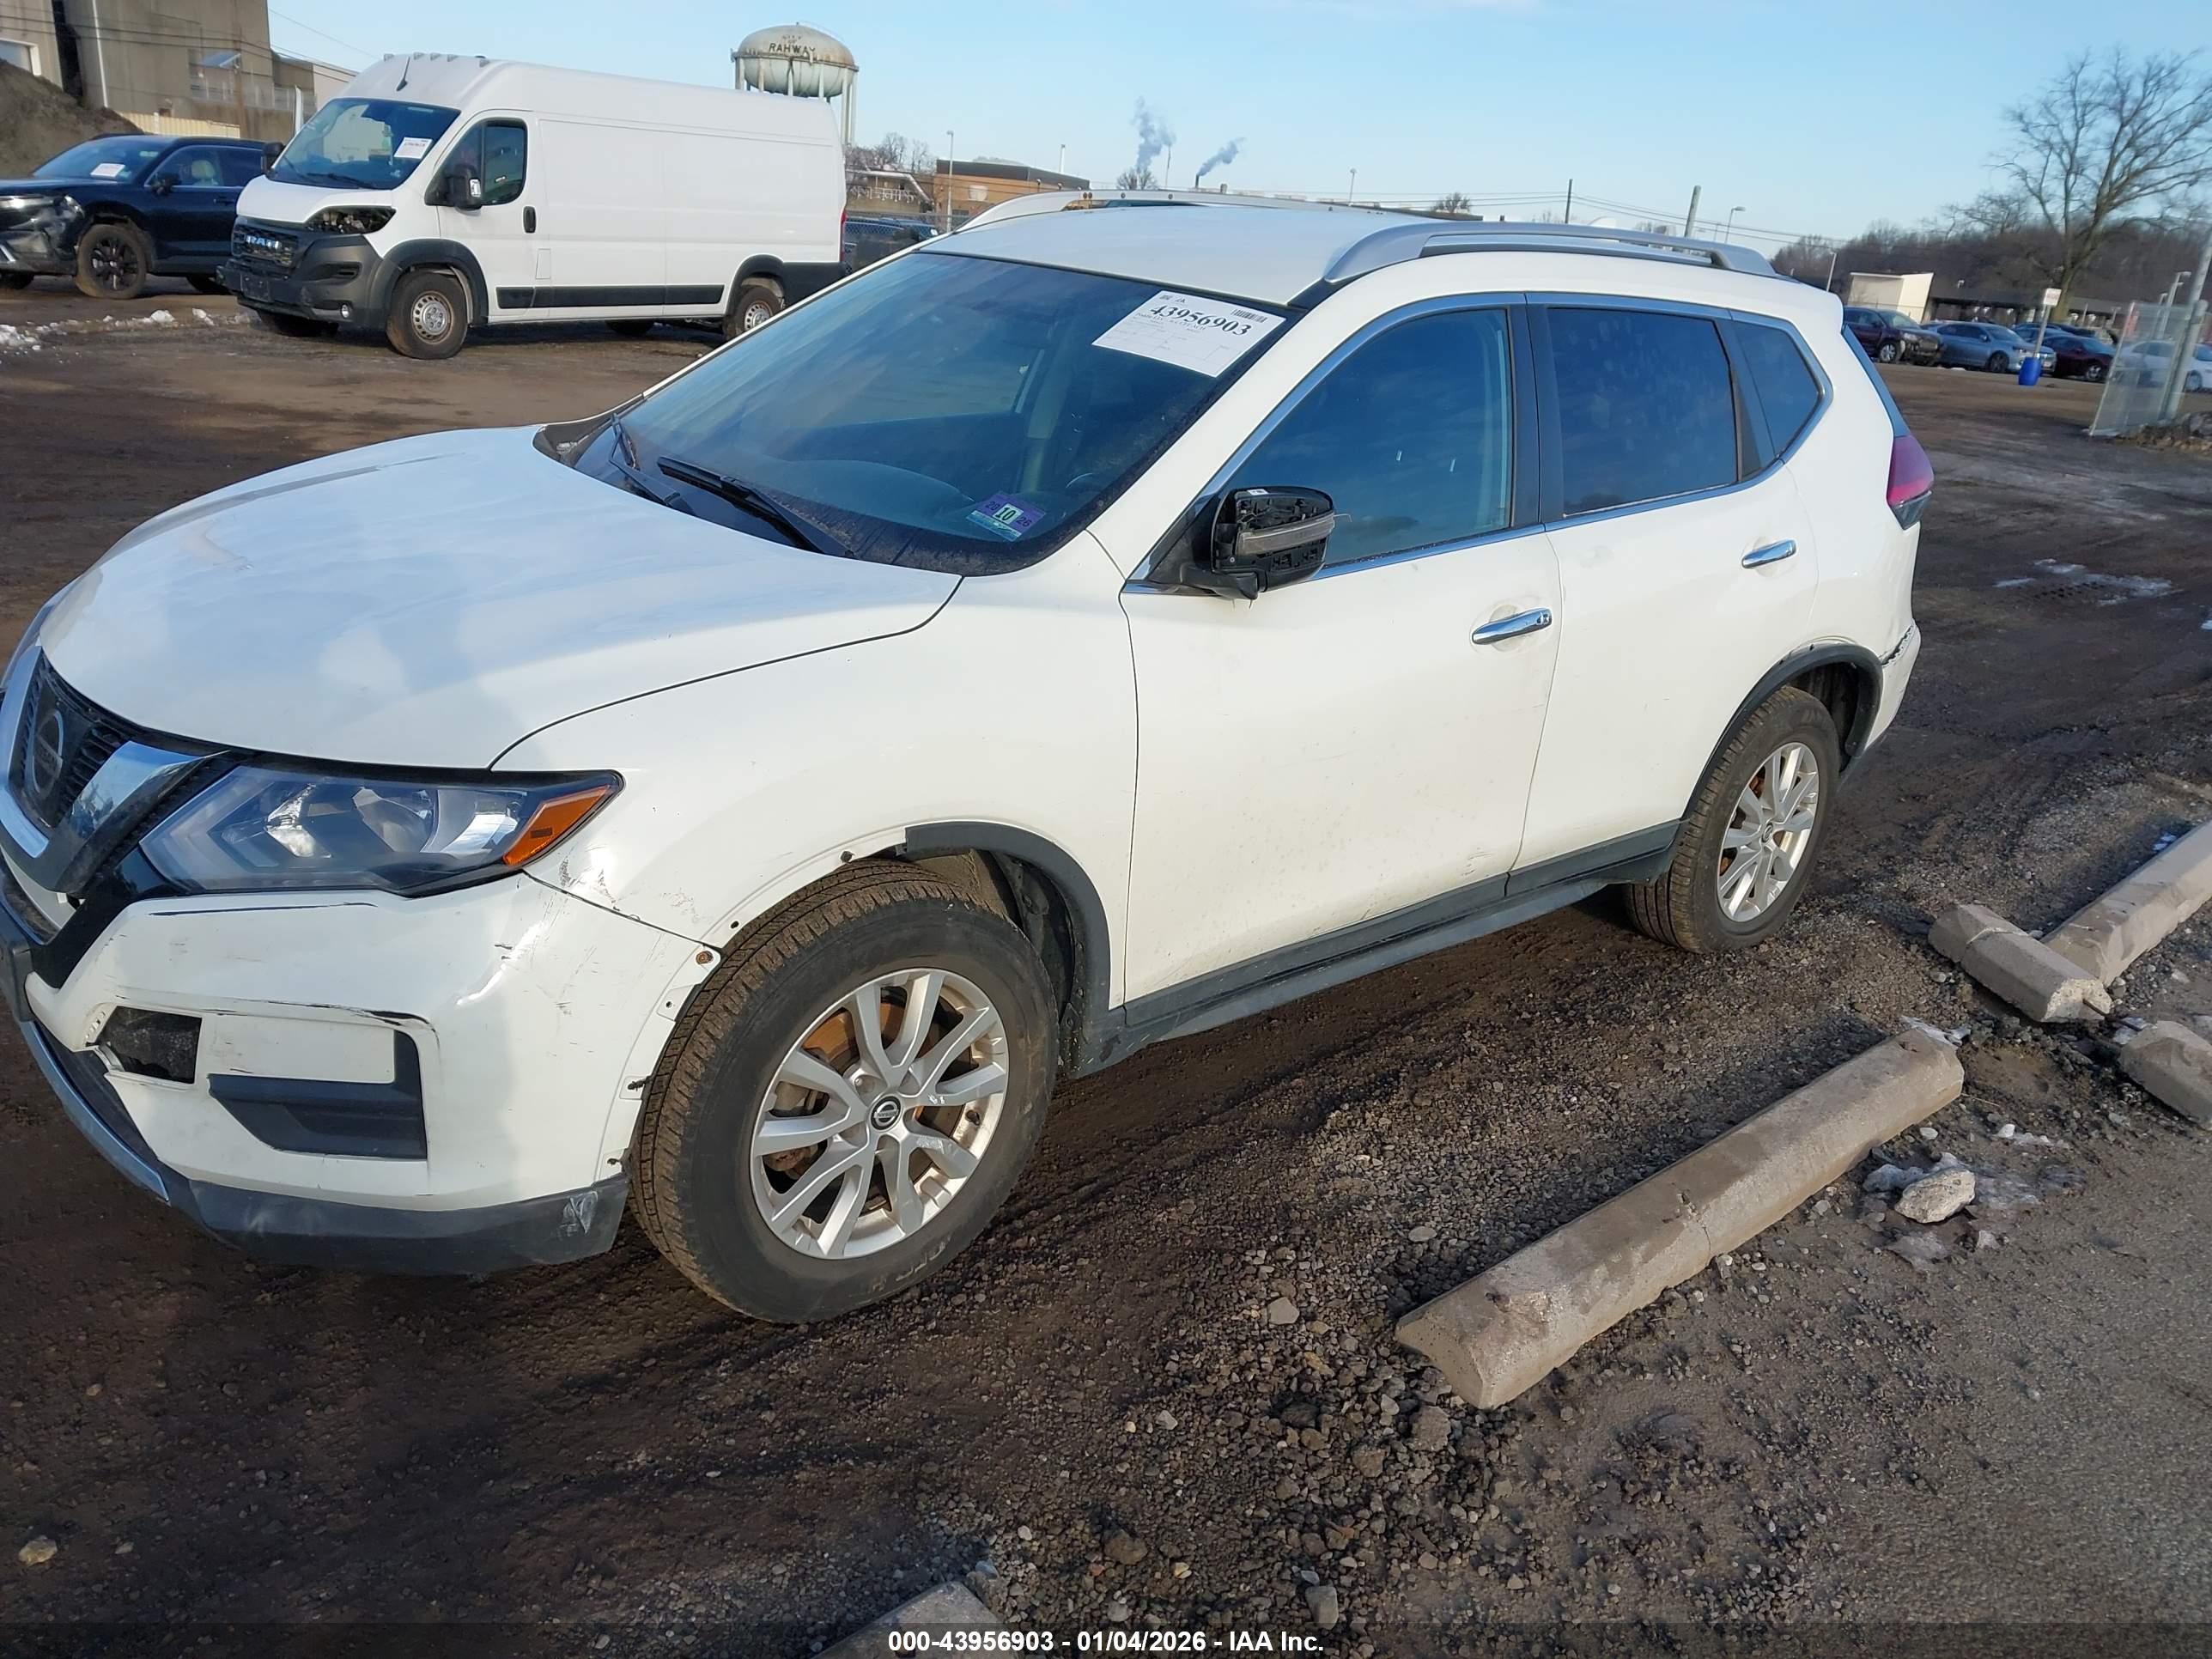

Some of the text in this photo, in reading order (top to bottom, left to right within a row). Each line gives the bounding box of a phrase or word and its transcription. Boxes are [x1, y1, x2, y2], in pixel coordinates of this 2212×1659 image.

[769, 42, 816, 57] RAHWAY
[246, 234, 282, 250] RAM
[1150, 305, 1252, 336] 43956903
[994, 507, 1017, 521] 10
